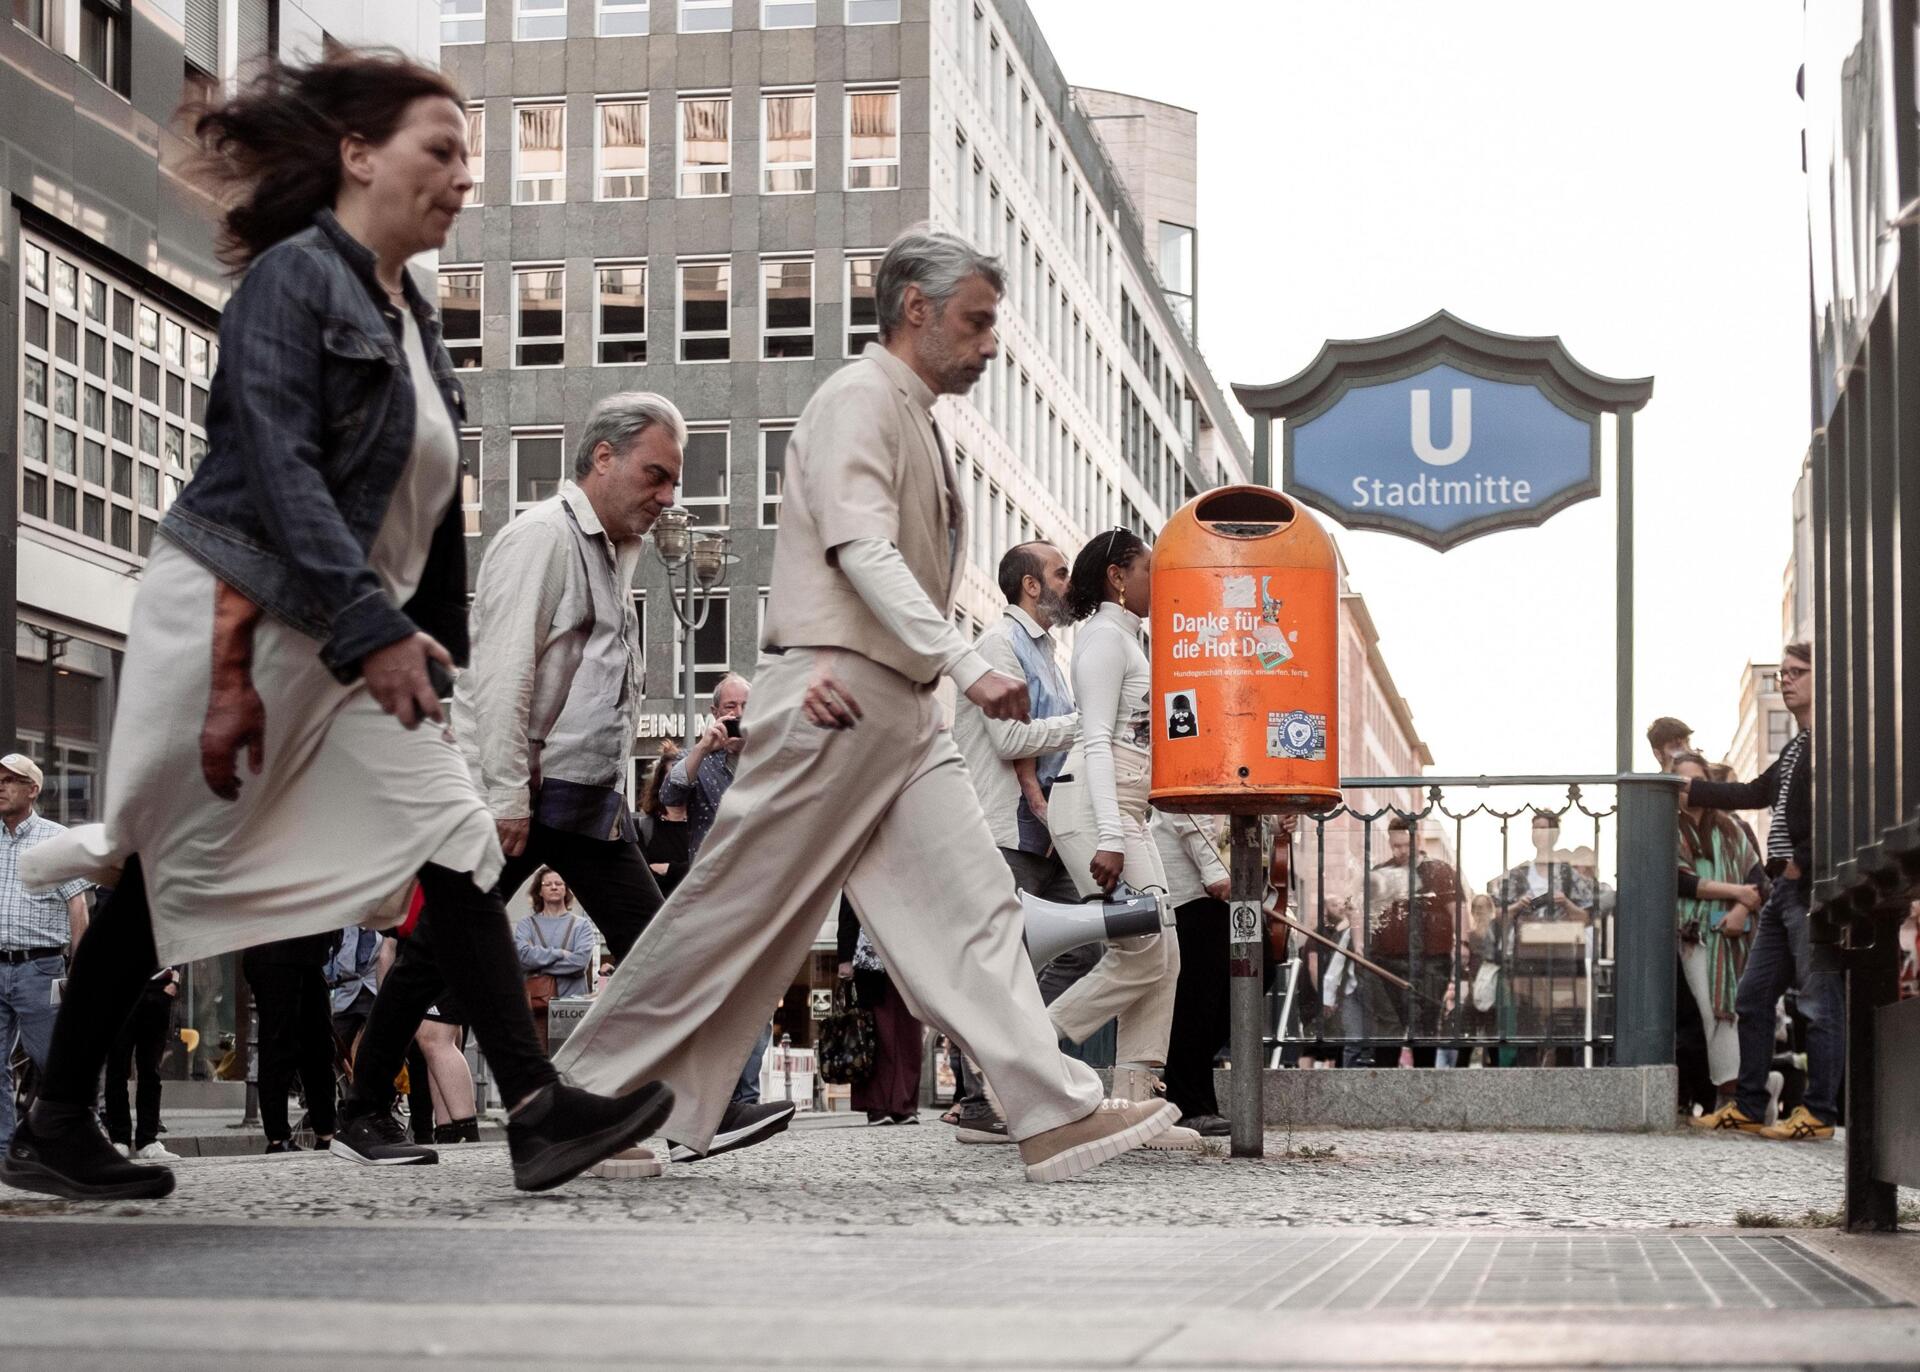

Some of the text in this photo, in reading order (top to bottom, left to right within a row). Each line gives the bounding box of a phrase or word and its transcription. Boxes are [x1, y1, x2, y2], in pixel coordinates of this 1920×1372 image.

[1411, 388, 1471, 466] U
[1352, 473, 1531, 507] Stadtmitte
[1172, 611, 1261, 633] Danke für
[1172, 639, 1200, 659] die
[1205, 638, 1238, 657] Hot
[1173, 669, 1223, 678] Hundegeschäft
